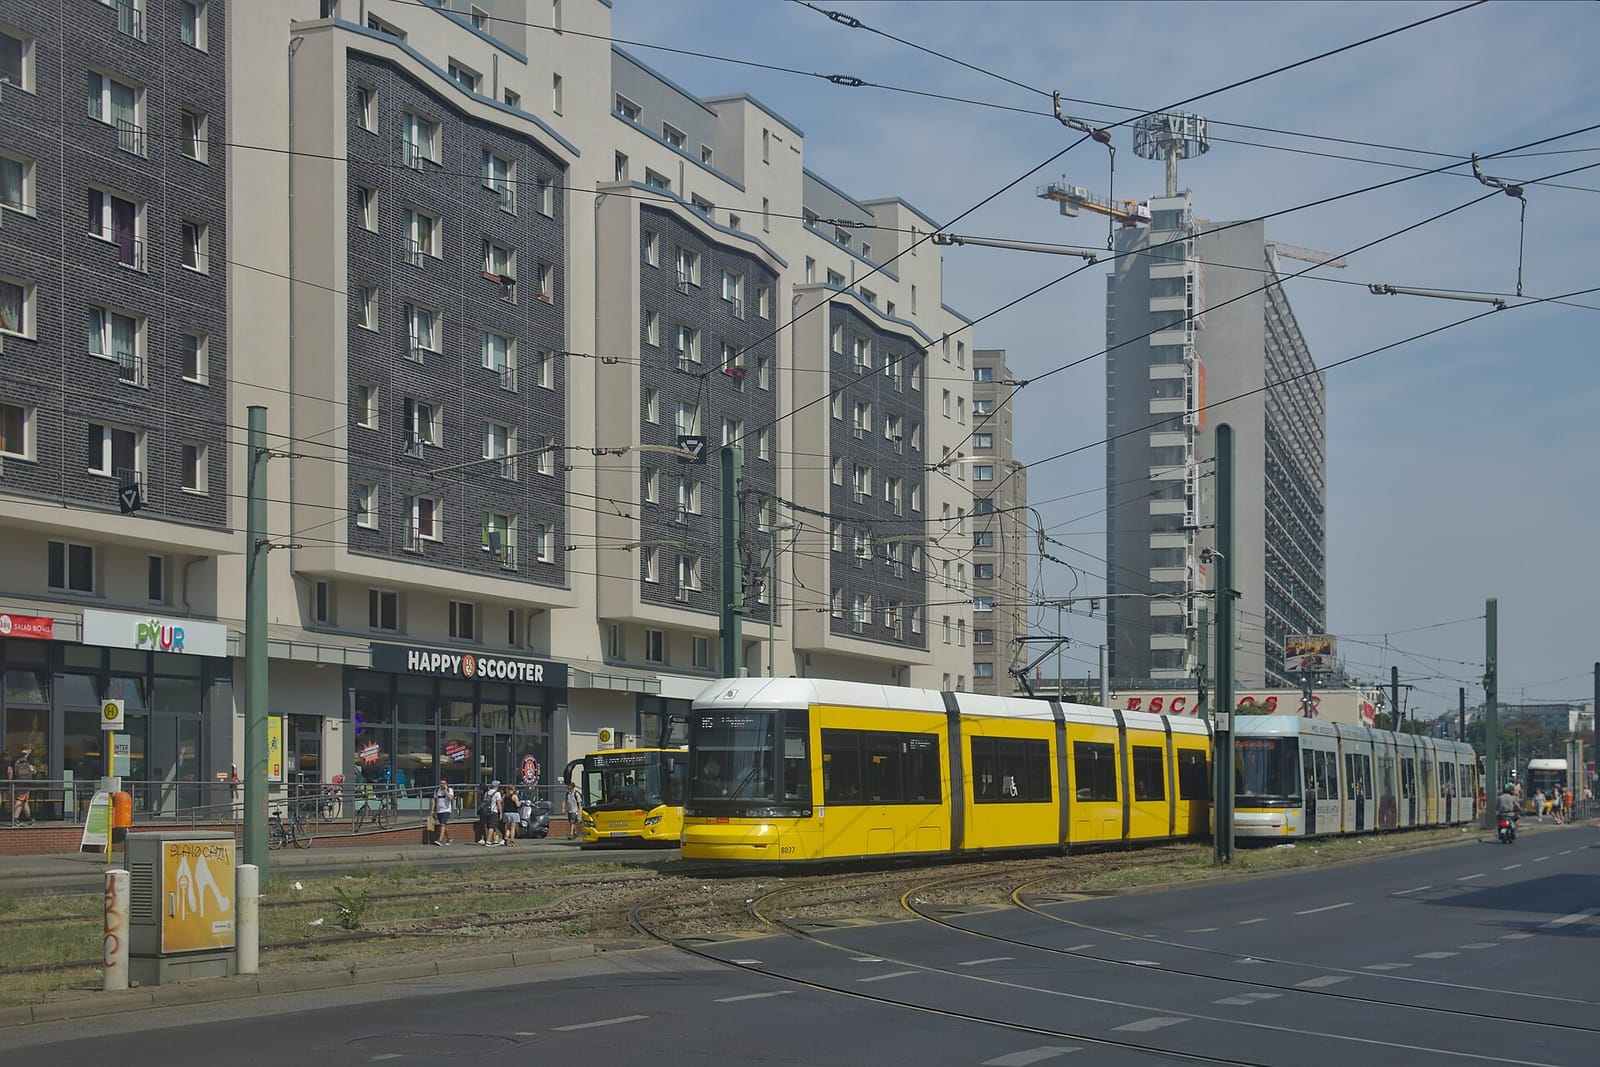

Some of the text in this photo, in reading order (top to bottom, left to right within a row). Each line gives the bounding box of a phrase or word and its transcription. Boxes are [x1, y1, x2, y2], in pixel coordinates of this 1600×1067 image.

[14, 623, 31, 632] SALAD
[408, 650, 543, 682] HAPPY SCOOTER
[780, 846, 796, 854] 8037
